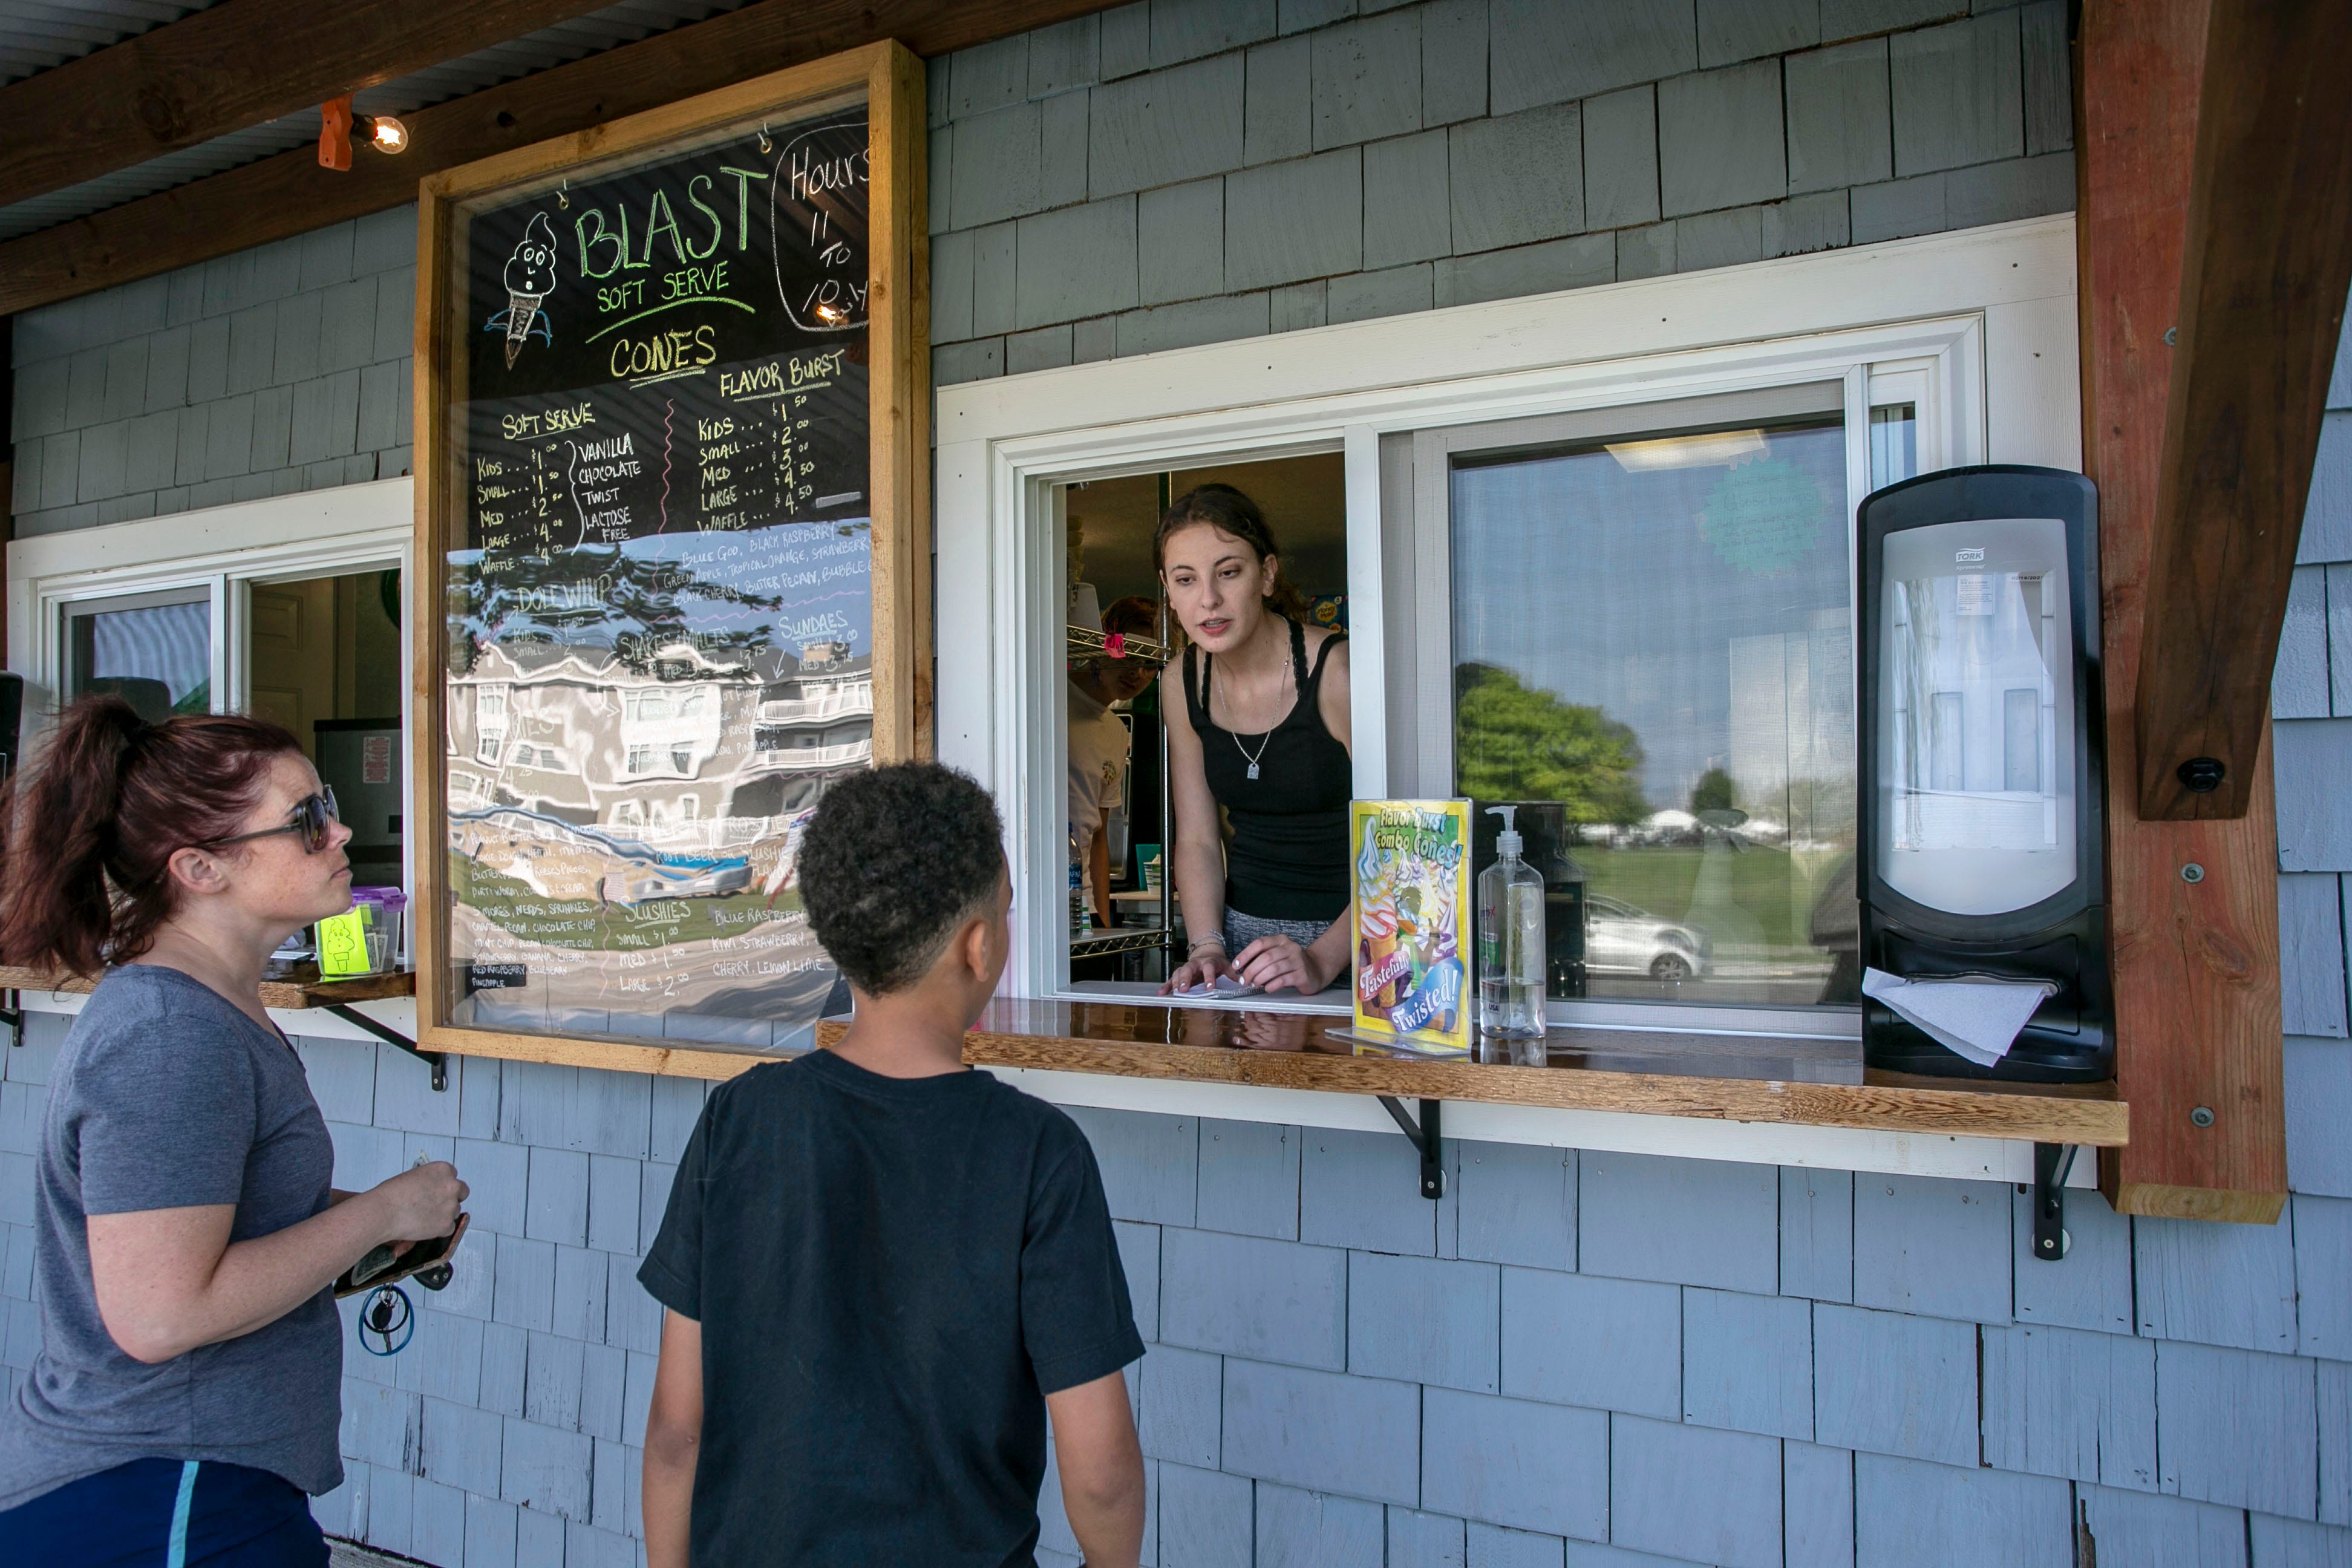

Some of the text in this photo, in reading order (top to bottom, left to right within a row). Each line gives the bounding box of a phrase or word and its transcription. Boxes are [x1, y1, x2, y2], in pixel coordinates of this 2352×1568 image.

[576, 166, 769, 278] BLAST
[597, 261, 729, 313] SOFT SERVE
[611, 326, 716, 377] CONES
[720, 349, 845, 397] FLAVOR BURST
[503, 402, 596, 440] SOFT SERVE
[699, 417, 734, 441] KIDS
[579, 433, 634, 463] VANILLA
[699, 441, 740, 466] SMALL
[579, 461, 641, 486] CHOCOLATE
[477, 485, 509, 505] SMALL
[581, 488, 619, 505] TWIST
[702, 485, 737, 511] LARGE
[585, 506, 632, 530] LACTOSE
[697, 511, 748, 537] WAFFLE
[602, 528, 630, 543] FREE
[682, 551, 713, 568] BLUE
[750, 535, 779, 552] BLACK
[783, 521, 835, 546] RASPBERRY
[479, 556, 515, 575] WAFFLE
[664, 572, 693, 589] GREEN
[728, 559, 767, 577] TROPICAL
[517, 574, 612, 613] DOLE WHIP
[673, 589, 702, 606] BLACK
[745, 575, 780, 593] BUTTER
[822, 561, 865, 582] BUBBLE
[779, 610, 848, 640] SUNDAES
[621, 632, 671, 661] SHAKES
[683, 626, 730, 650] MALTS
[684, 849, 719, 864] BEER
[1374, 829, 1464, 870] Combo Cones!
[621, 895, 691, 923] SLUSHIES
[715, 910, 744, 926] BLUE
[533, 921, 576, 933] CHOCOLATE
[475, 938, 494, 948] MINT
[546, 938, 577, 948] CHOCOLATE
[712, 936, 736, 952] KIWI
[472, 964, 486, 975] RED
[757, 961, 790, 975] LEMON
[793, 957, 825, 972] LIME
[1359, 954, 1410, 999] Tastefully
[472, 978, 505, 988] PINEAPPLE
[1391, 967, 1458, 1031] Twisted!
[1489, 1003, 1499, 1011] USA
